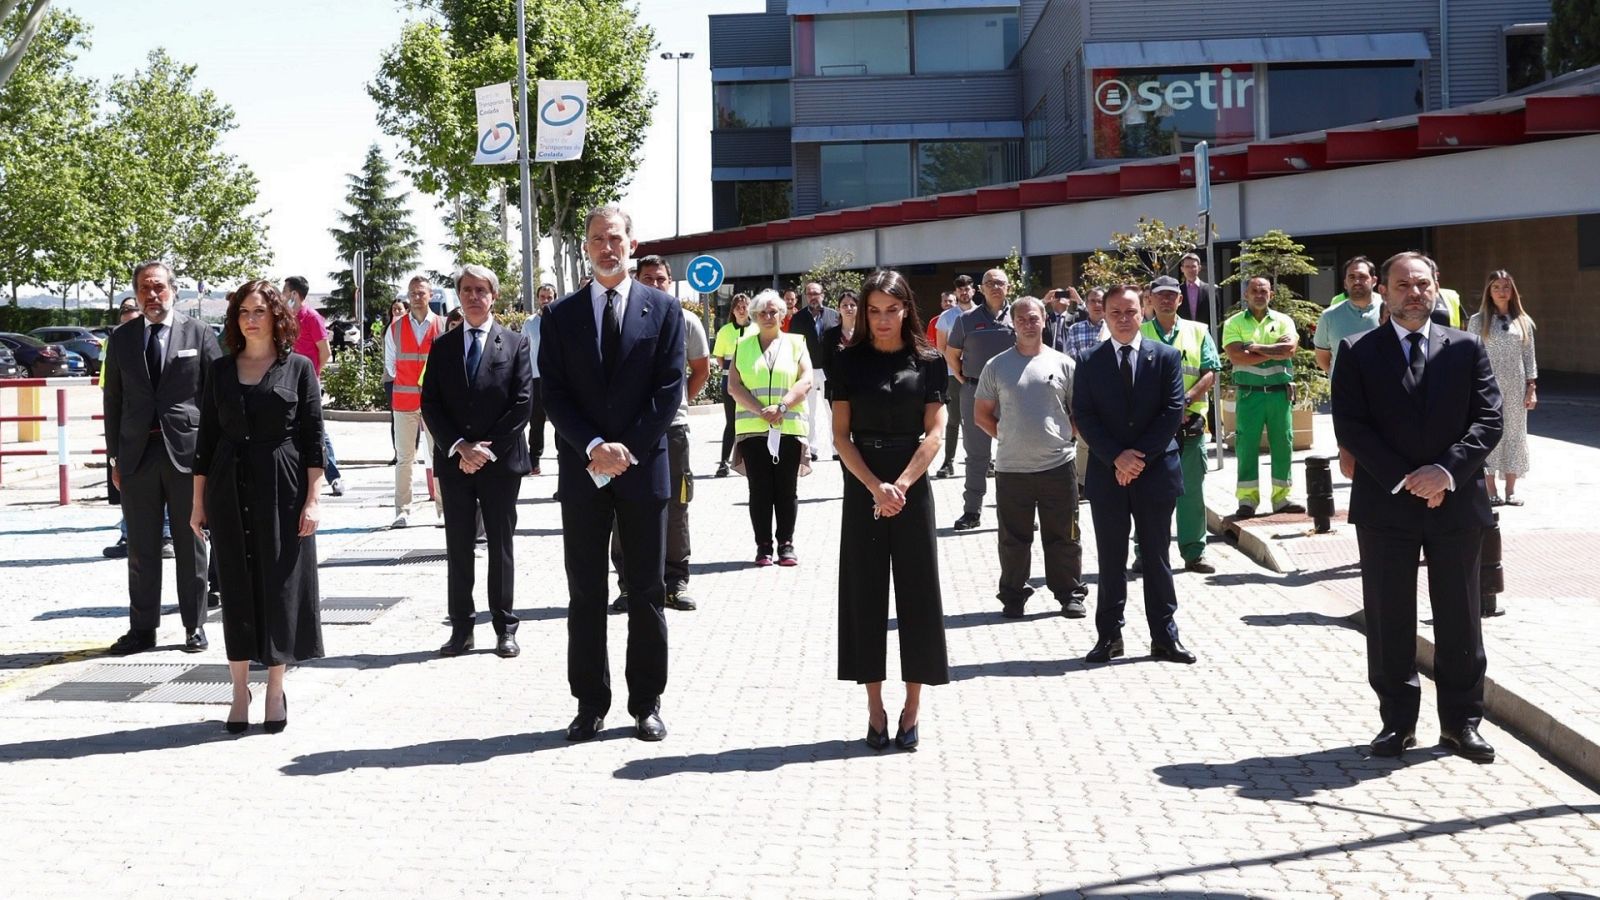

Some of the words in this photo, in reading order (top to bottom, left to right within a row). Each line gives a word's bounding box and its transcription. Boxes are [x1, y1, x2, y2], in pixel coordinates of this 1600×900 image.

[1137, 67, 1255, 112] setir
[479, 108, 499, 116] Coslada
[539, 143, 572, 151] Transportes
